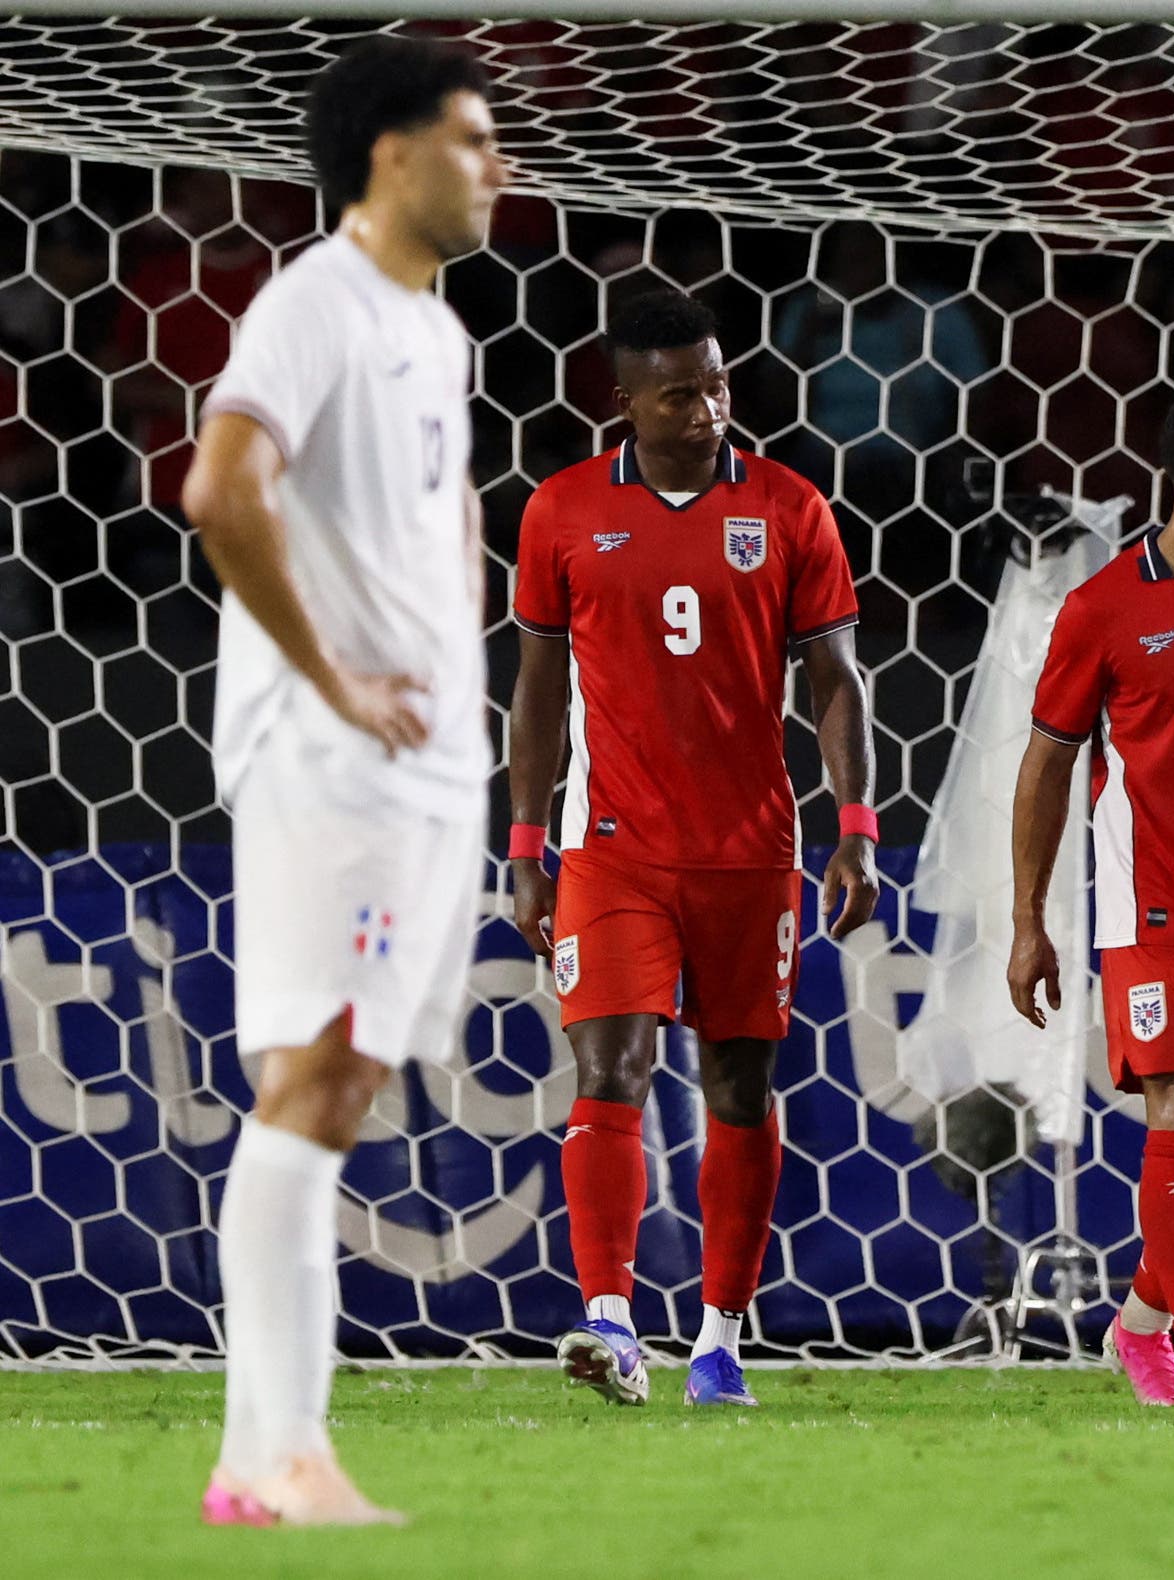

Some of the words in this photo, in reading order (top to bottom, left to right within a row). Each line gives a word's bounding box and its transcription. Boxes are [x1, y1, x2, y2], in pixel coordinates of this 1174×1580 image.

[592, 531, 631, 542] Reebok
[662, 585, 701, 655] 9
[777, 910, 795, 980] 9
